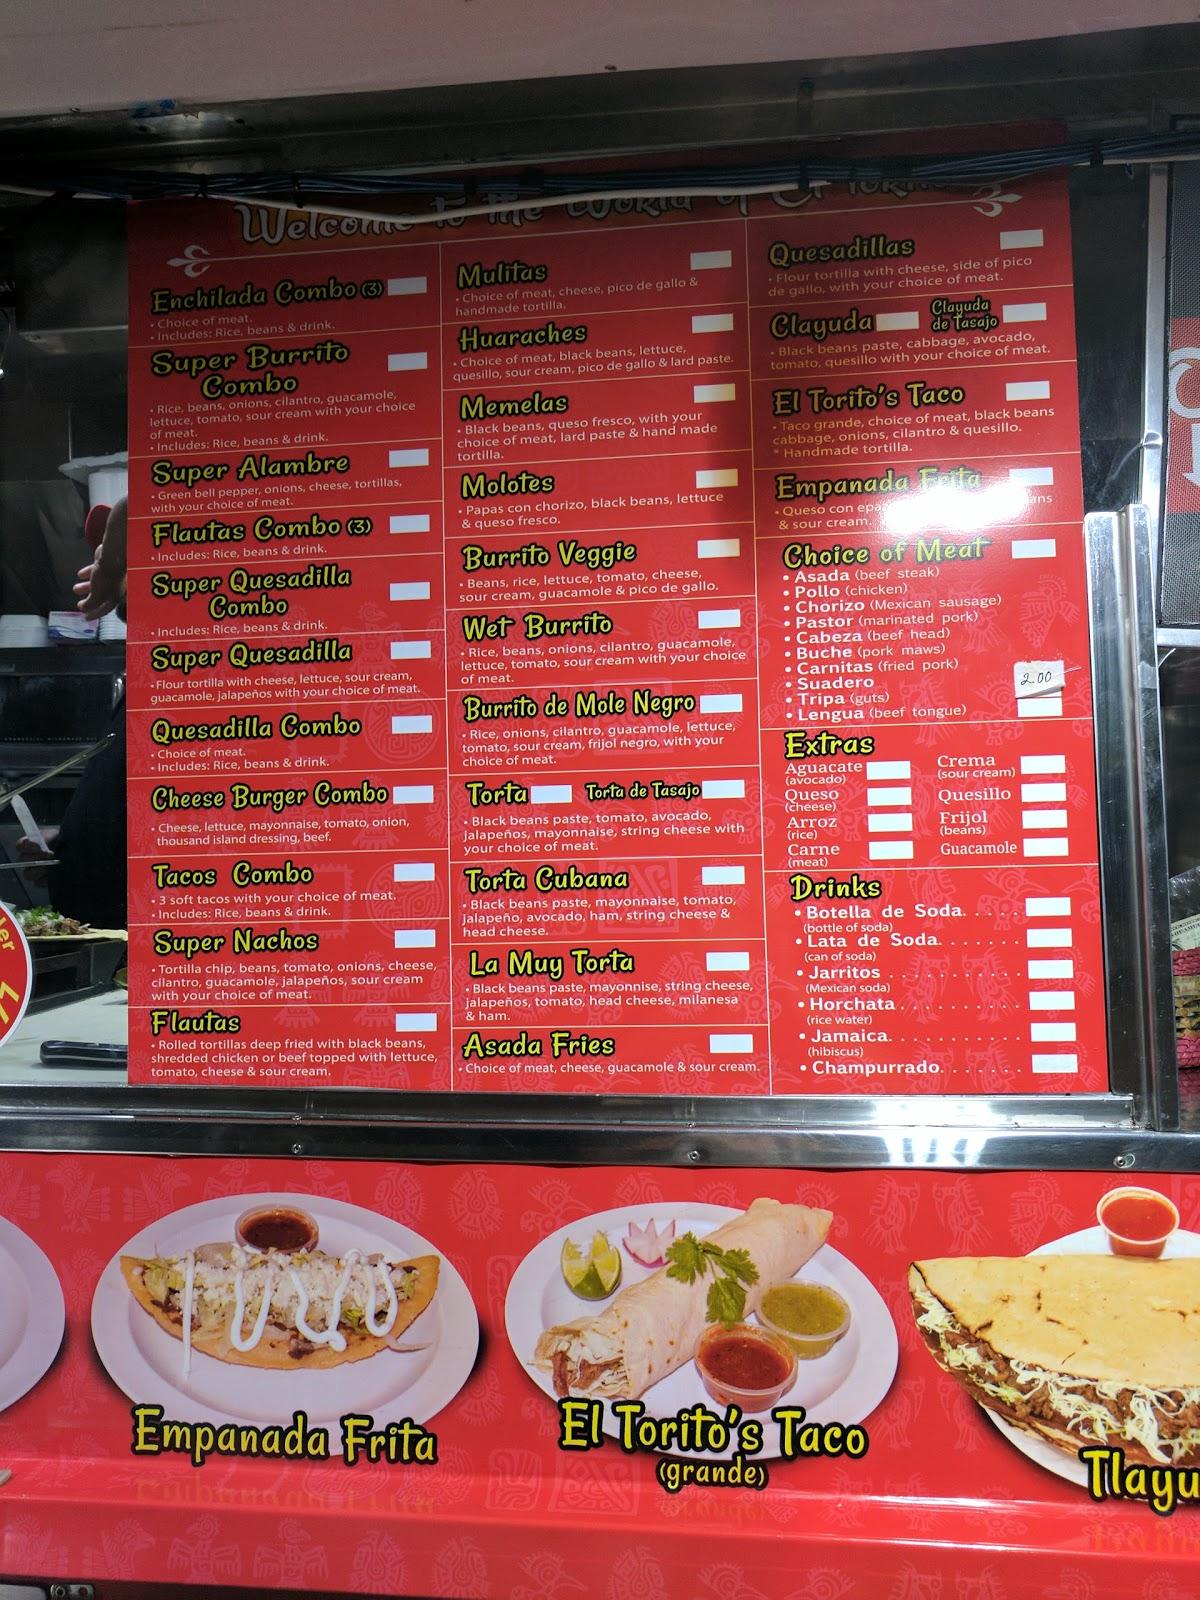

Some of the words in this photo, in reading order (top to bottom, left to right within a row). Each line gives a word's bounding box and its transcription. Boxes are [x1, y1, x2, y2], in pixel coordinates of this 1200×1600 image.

[770, 236, 914, 265] Quesadillas
[458, 263, 547, 287] Mulitas
[153, 284, 266, 313] Enchilada
[275, 279, 356, 304] Combo
[362, 283, 382, 297] (3)
[932, 299, 989, 315] Clayuda
[770, 311, 872, 339] Clayuda
[932, 317, 948, 331] de
[954, 314, 997, 331] Tasajo
[460, 324, 587, 350] Huaraches
[153, 352, 235, 377] Super
[247, 341, 348, 370] Burrito
[203, 372, 297, 398] Combo
[461, 394, 568, 419] Memelas
[774, 391, 799, 414] El
[808, 385, 899, 412] Torito's
[906, 383, 964, 407] Taco
[153, 461, 227, 487] Super
[238, 455, 349, 480] Alambre
[462, 472, 553, 497] Molotes
[776, 470, 909, 501] Empanada
[153, 522, 245, 547] Flautas
[254, 515, 340, 540] Combo
[347, 519, 372, 534] (3)
[463, 544, 549, 570] Burrito
[558, 541, 636, 567] Veggie
[783, 543, 869, 568] Choice
[880, 543, 903, 564] of
[916, 539, 991, 562] Meat
[153, 573, 220, 598] Super
[230, 566, 350, 592] Quesadilla
[795, 570, 849, 583] Asada
[855, 568, 890, 580] (beef
[898, 566, 940, 579] steak)
[795, 585, 840, 598] Pollo
[845, 583, 908, 595] (chicken)
[209, 594, 288, 618] Combo
[795, 600, 864, 613] Chorizo
[870, 598, 931, 611] (Mexican
[939, 595, 1002, 609] sausage)
[463, 616, 514, 640] Wet
[525, 612, 612, 638] Burrito
[796, 616, 853, 629] Pastor
[859, 613, 934, 627] (marinated
[942, 612, 979, 624] pork)
[797, 631, 862, 644] Cabeza
[867, 629, 903, 642] (beef
[910, 628, 950, 640] head)
[153, 647, 220, 672] Super
[229, 640, 351, 668] Quesadilla
[796, 646, 852, 660] Buche
[858, 644, 893, 657] (pork
[901, 643, 946, 656] maws)
[797, 661, 873, 674] Carnitas
[878, 660, 915, 672] (fried
[923, 658, 959, 671] pork)
[797, 677, 874, 690] Suadero
[1021, 671, 1052, 686] 2.00
[463, 695, 537, 720] Burrito
[545, 694, 568, 716] de
[576, 693, 625, 716] Mole
[634, 691, 695, 716] Negro
[798, 692, 845, 707] Tripa
[850, 691, 890, 704] (guts)
[798, 708, 864, 723] Lengua
[870, 706, 905, 719] (beef
[912, 704, 967, 718] tongue)
[152, 717, 271, 743] Quesadilla
[280, 714, 361, 737] Combo
[785, 731, 873, 758] Extras
[785, 761, 863, 775] Aguacate
[937, 755, 995, 768] Crema
[785, 774, 846, 786] (avocado)
[938, 768, 969, 780] (sour
[973, 767, 1016, 778] cream)
[152, 788, 224, 811] Cheese
[232, 784, 306, 810] Burger
[314, 782, 387, 805] Combo
[467, 781, 527, 806] Torta
[587, 784, 624, 800] Torta
[630, 783, 647, 798] de
[652, 782, 700, 799] Tasajo
[784, 789, 839, 802] Queso
[938, 788, 1011, 802] Quesillo
[785, 801, 837, 813] (cheese)
[786, 816, 838, 828] Arroz
[939, 811, 988, 825] Frijol
[787, 829, 818, 840] (rice)
[939, 824, 986, 836] (beans)
[787, 843, 840, 856] Carne
[940, 841, 1017, 855] Guacamole
[788, 857, 828, 868] (meat)
[153, 864, 216, 887] Tacos
[233, 862, 313, 885] Combo
[465, 869, 525, 892] Torta
[535, 866, 628, 891] Cubana
[790, 874, 881, 900] Drinks
[807, 905, 871, 919] Botella
[882, 905, 904, 918] de
[803, 922, 841, 934] (bottle
[844, 922, 855, 932] of
[860, 922, 893, 933] soda)
[154, 930, 224, 958] Super
[233, 929, 318, 952] Nachos
[807, 935, 847, 947] Lata
[857, 934, 880, 947] de
[470, 951, 498, 976] La
[509, 951, 563, 978] Muy
[571, 949, 633, 973] Torta
[804, 951, 826, 962] (can
[830, 951, 841, 961] of
[845, 951, 877, 962] soda)
[808, 966, 880, 979] Jarritos
[805, 983, 855, 994] (Mexican
[858, 983, 891, 994] soda)
[810, 998, 895, 1011] Horchata
[151, 1012, 240, 1034] Flautas
[807, 1015, 832, 1026] (rice
[835, 1015, 873, 1026] water)
[158, 1039, 197, 1050] Rolled
[200, 1039, 247, 1050] tortillas
[250, 1039, 281, 1051] deep
[285, 1038, 314, 1049] fried
[317, 1038, 344, 1049] with
[348, 1038, 382, 1049] black
[385, 1038, 426, 1049] beans,
[463, 1033, 541, 1057] Asada
[552, 1032, 614, 1056] Fries
[808, 1046, 864, 1057] (hibiscus)
[465, 1063, 506, 1074] Choice
[509, 1063, 521, 1073] of
[524, 1063, 557, 1075] meat,
[560, 1063, 604, 1075] cheese,
[608, 1062, 674, 1075] guacamole
[677, 1062, 686, 1072] &
[689, 1063, 715, 1072] sour
[719, 1062, 760, 1072] cream.
[134, 1408, 327, 1464] Empanada
[344, 1416, 437, 1463] Frita
[561, 1402, 604, 1448] El
[616, 1405, 761, 1453] Torito's
[777, 1407, 867, 1456] Taco
[660, 1457, 765, 1491] (grande)
